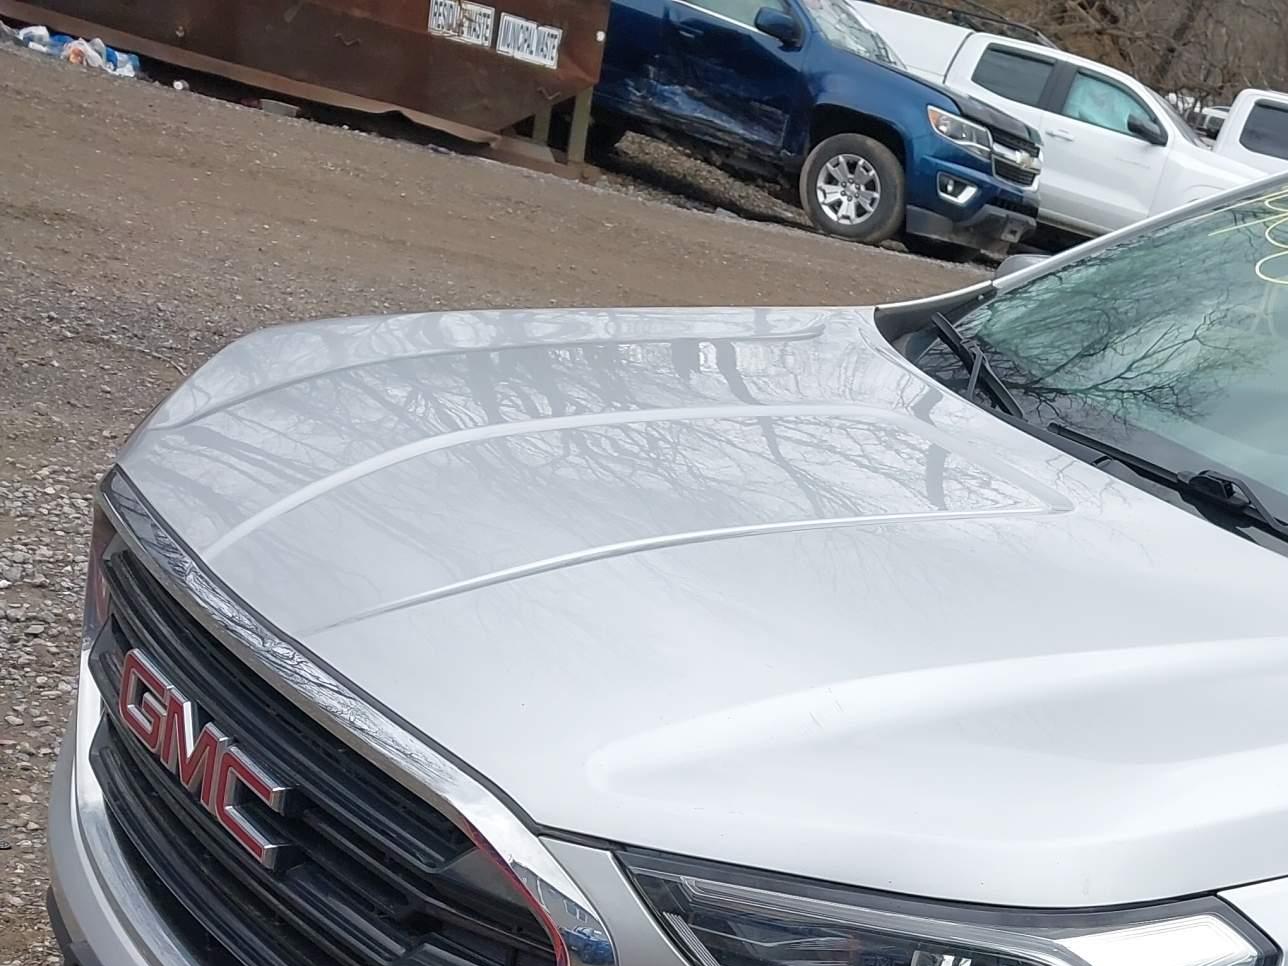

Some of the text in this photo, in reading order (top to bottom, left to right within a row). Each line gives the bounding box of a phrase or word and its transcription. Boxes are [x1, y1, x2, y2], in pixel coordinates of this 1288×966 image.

[502, 16, 558, 61] MUNICIPAL WASTE
[119, 648, 286, 873] GMC
